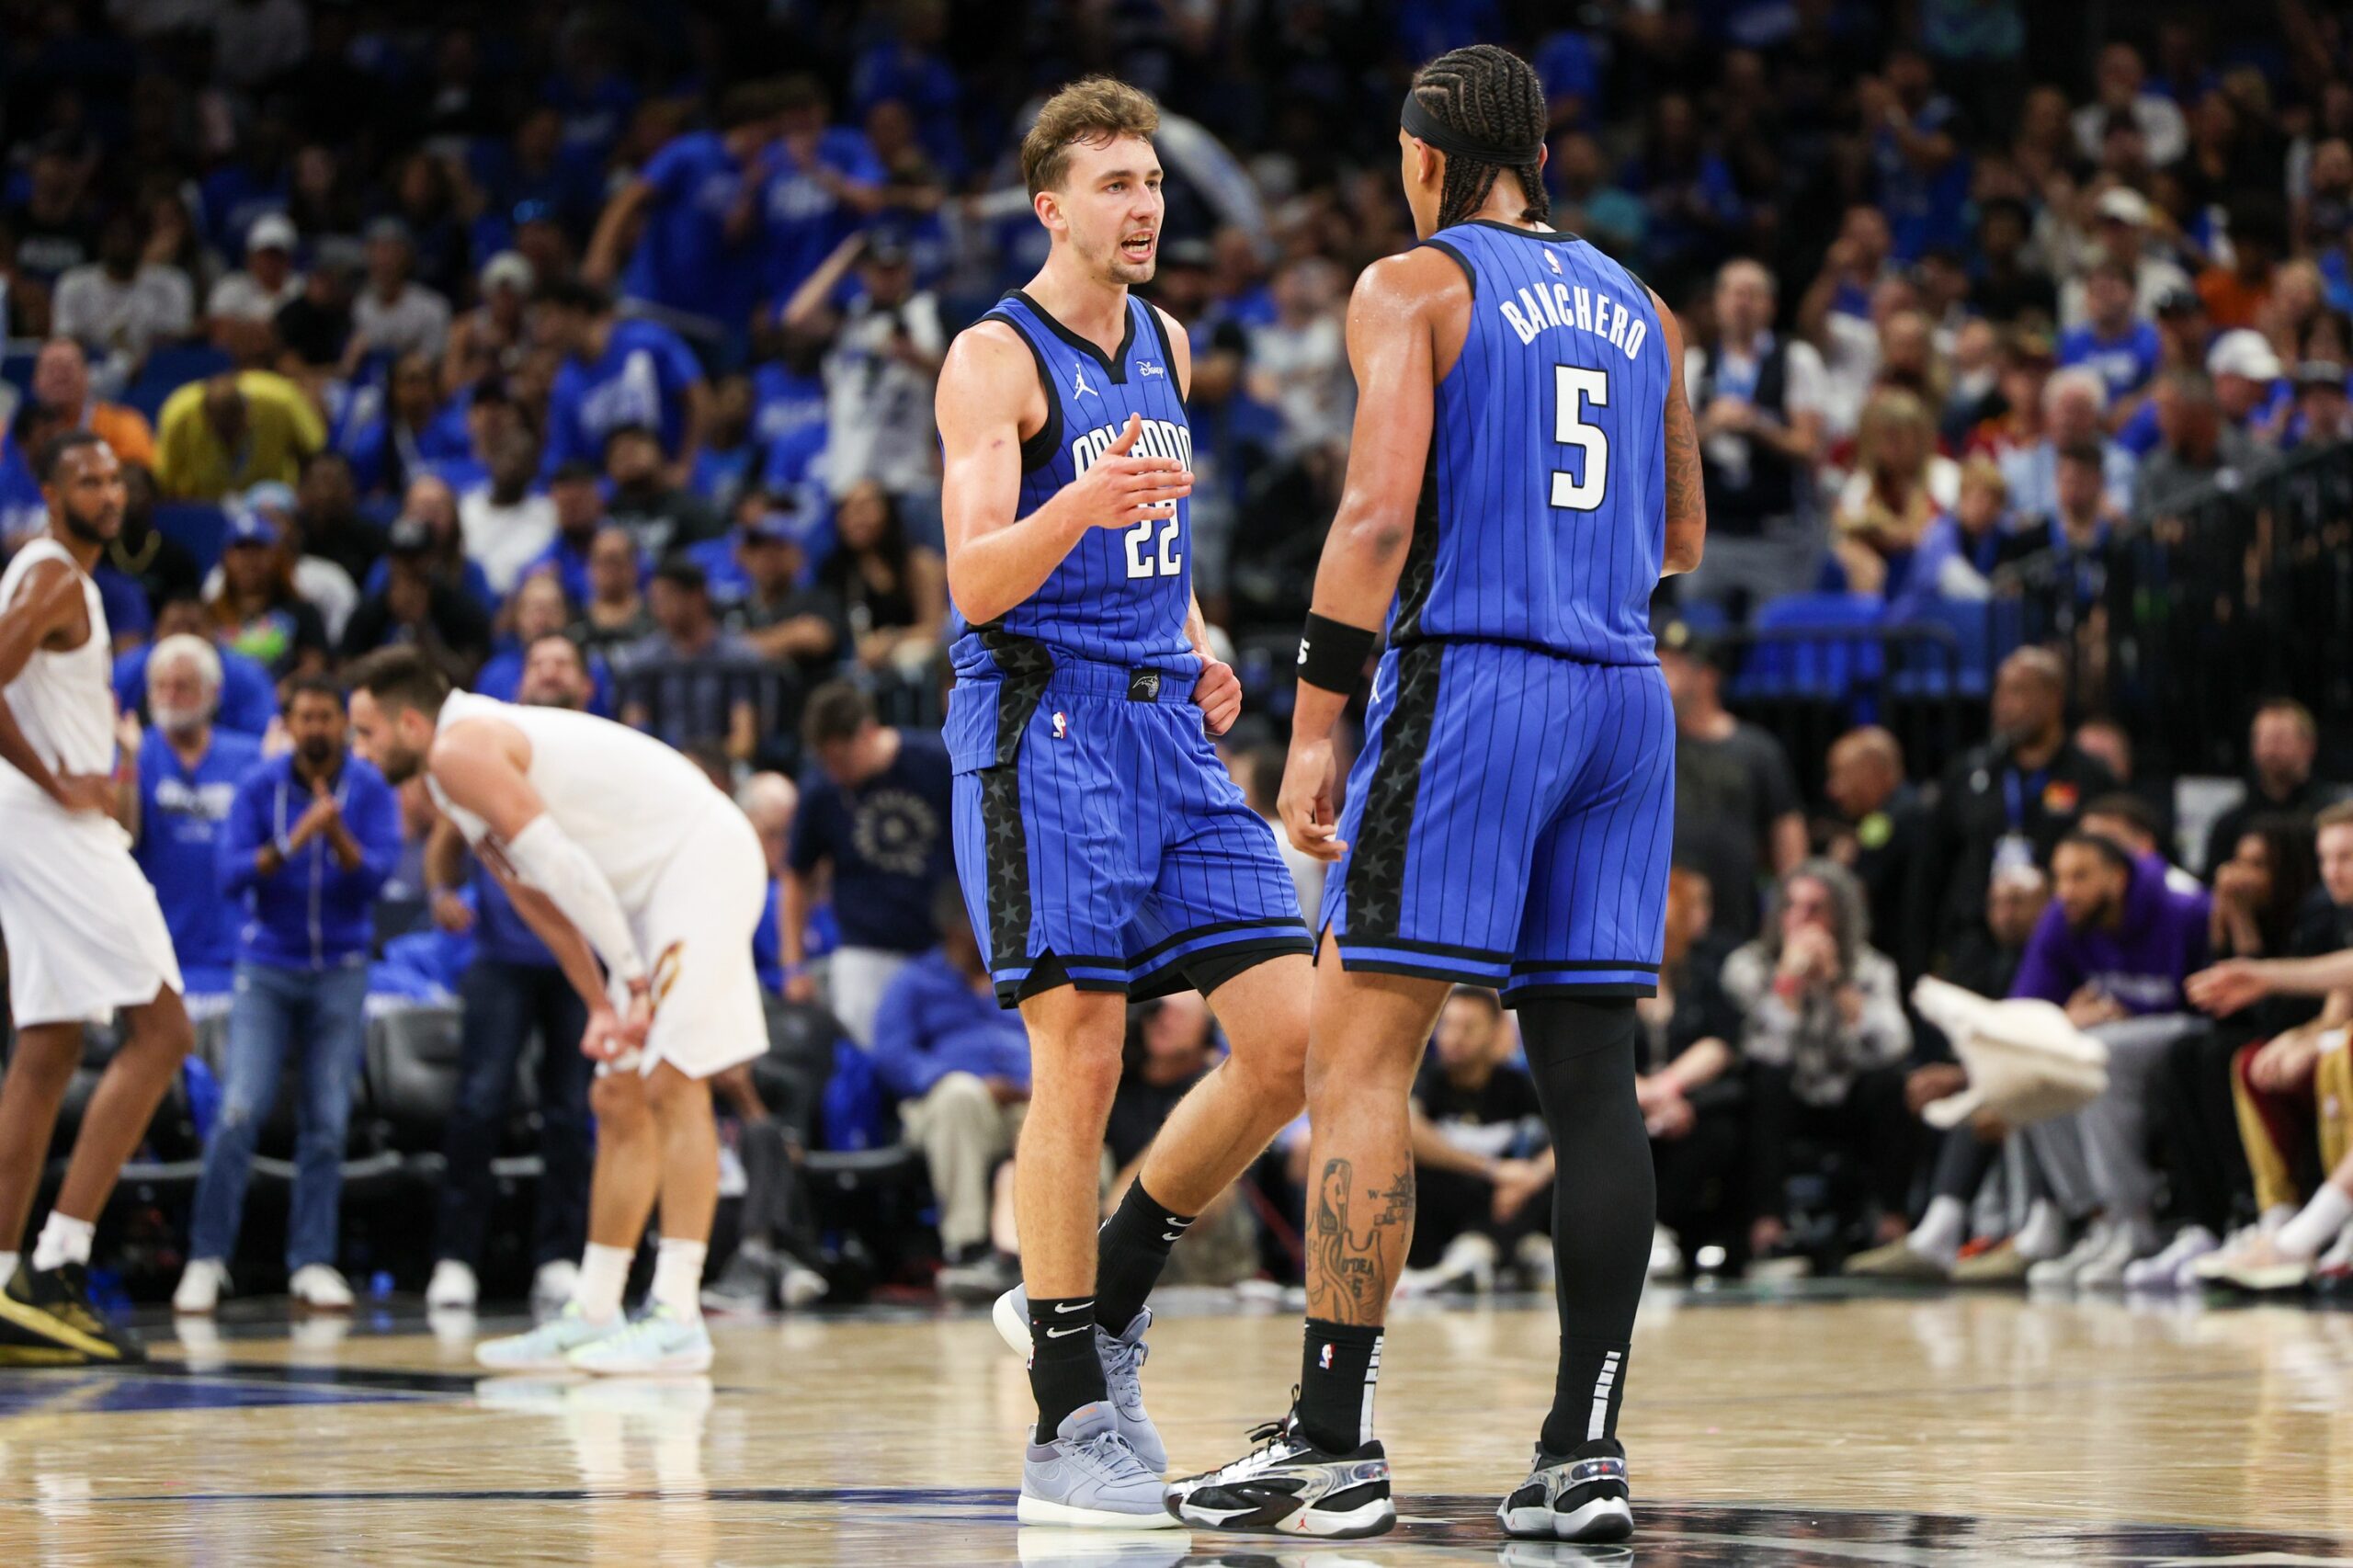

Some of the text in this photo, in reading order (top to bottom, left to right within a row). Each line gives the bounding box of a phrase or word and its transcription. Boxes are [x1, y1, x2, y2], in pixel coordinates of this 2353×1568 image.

[1500, 282, 1647, 360] BANCHERO
[1550, 364, 1608, 511] 5
[1124, 498, 1182, 579] 22
